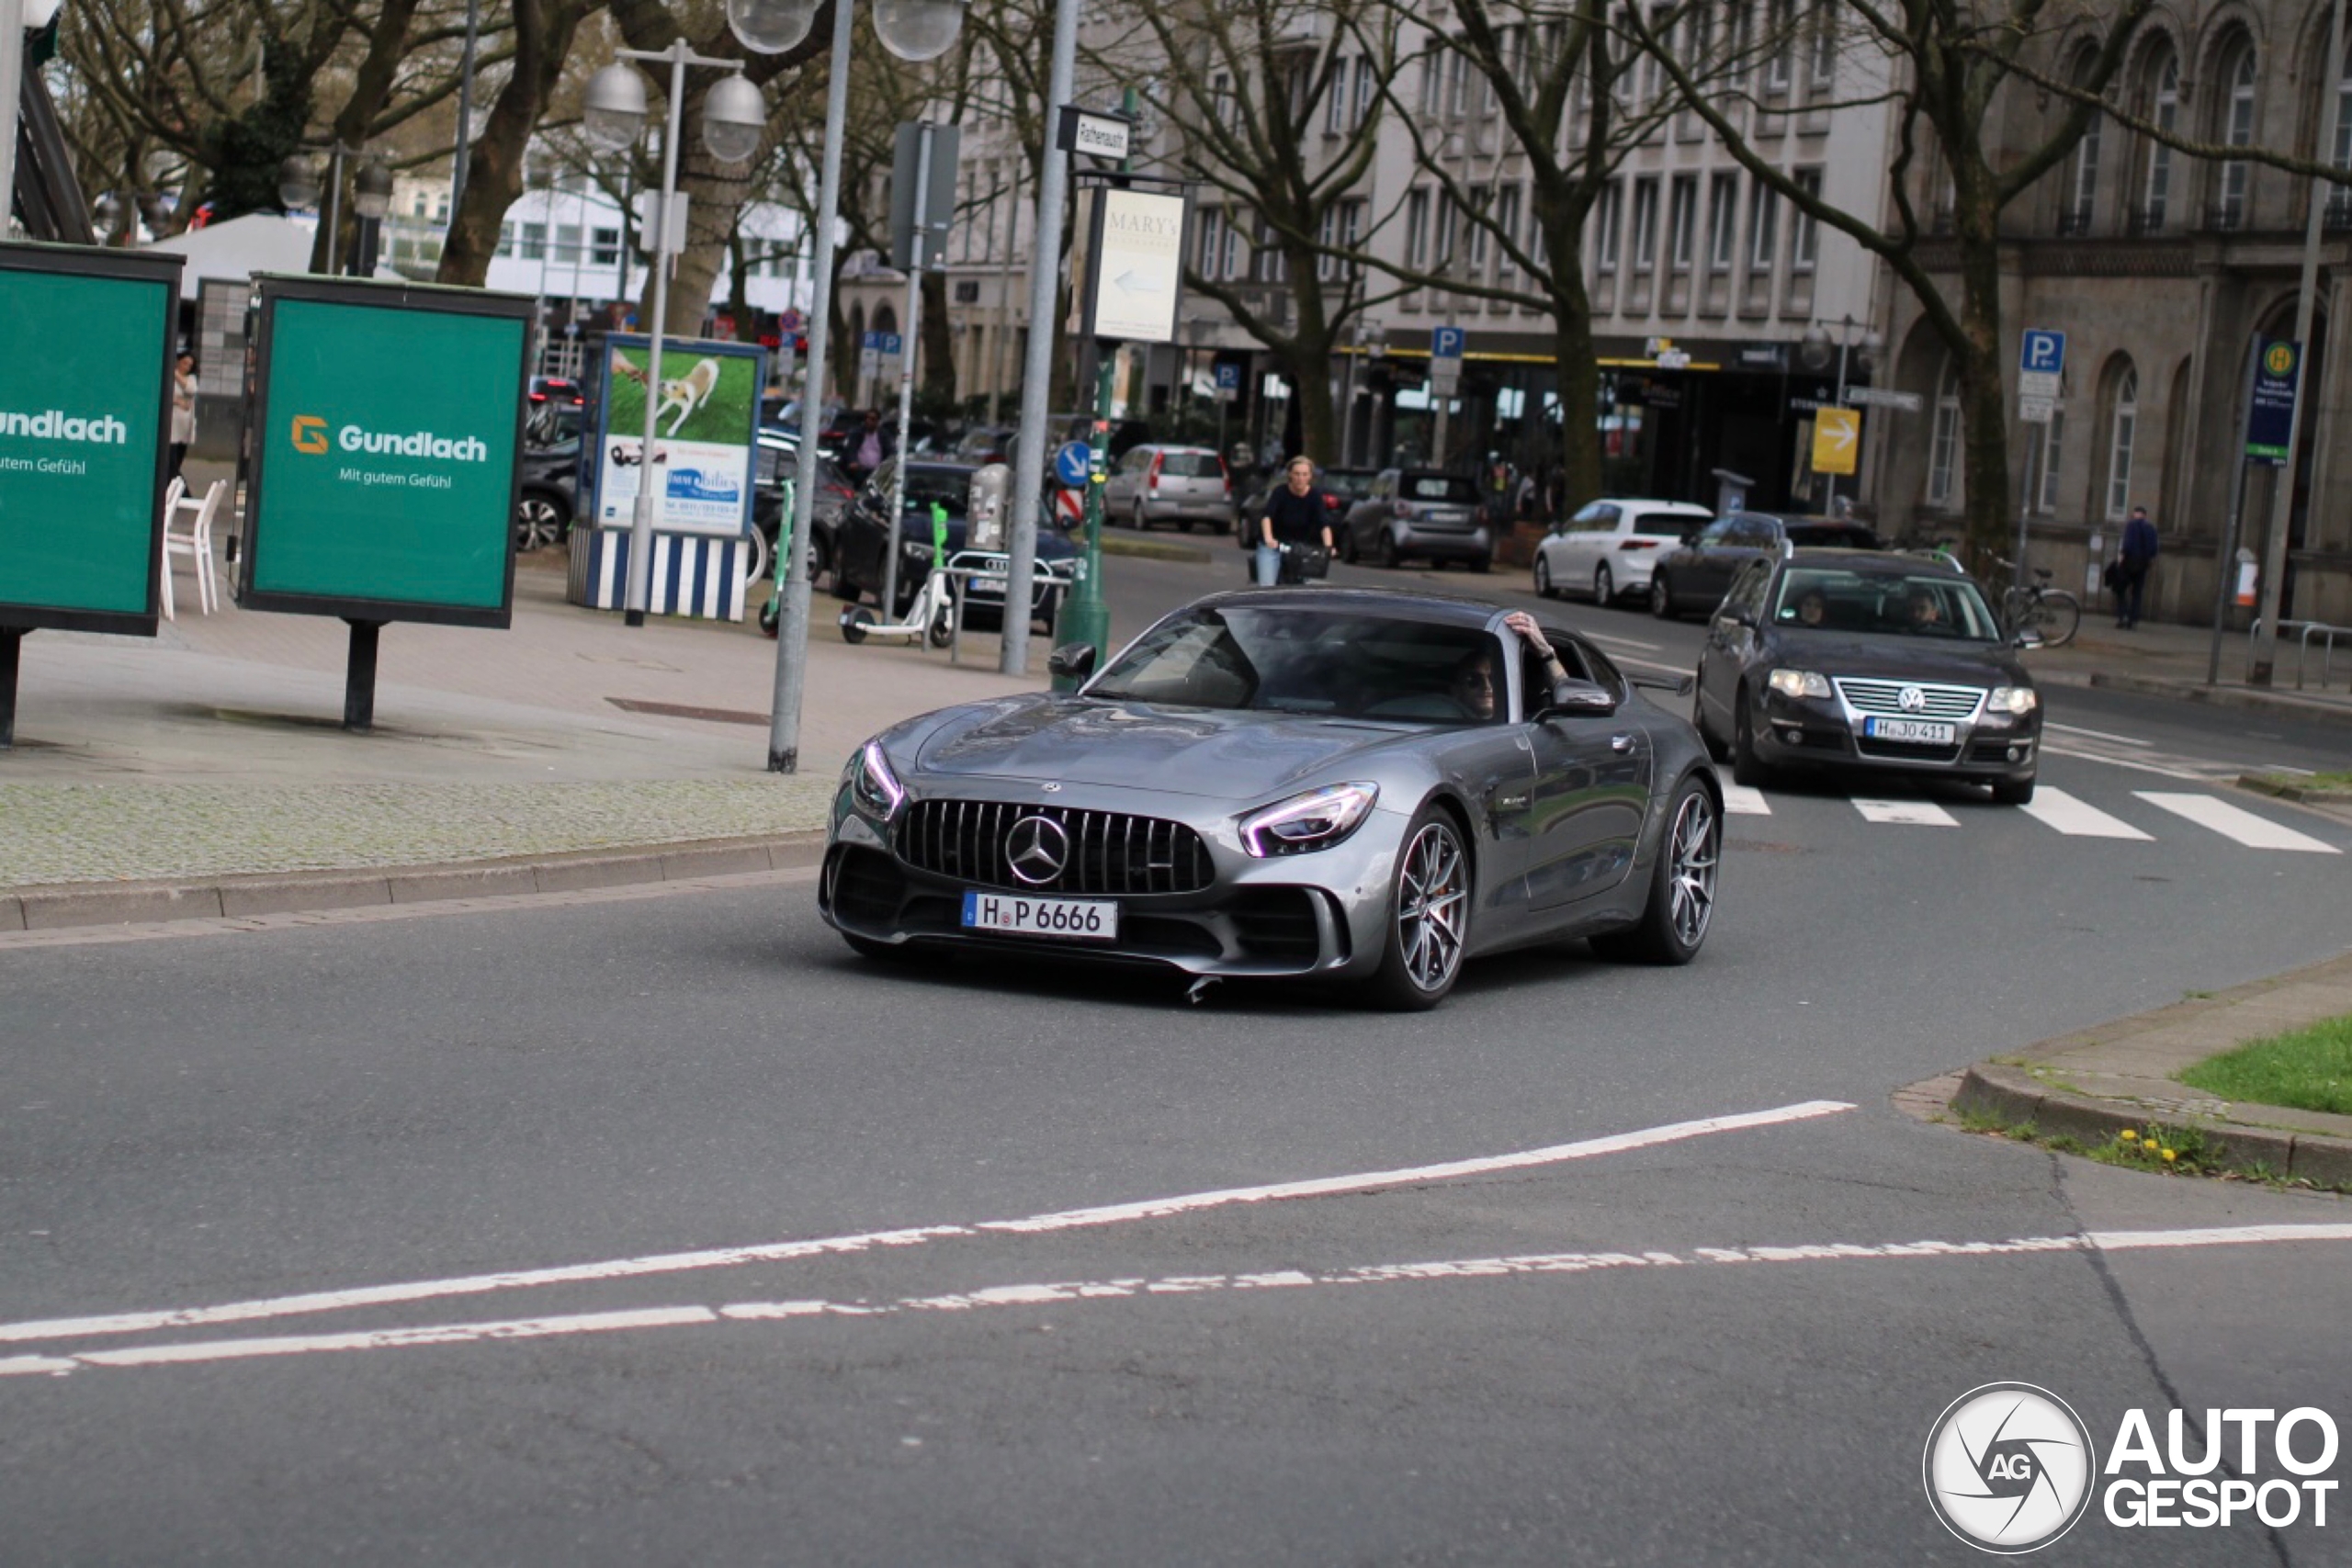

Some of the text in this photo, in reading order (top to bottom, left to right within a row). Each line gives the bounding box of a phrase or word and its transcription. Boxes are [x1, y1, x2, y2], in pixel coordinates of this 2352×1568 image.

[1439, 331, 1457, 354] P
[2031, 335, 2054, 367] P
[338, 424, 487, 462] Gundlach
[38, 457, 85, 475] Gefühl
[339, 468, 452, 489] Mit gutem Gefühl
[1879, 721, 1888, 735] H
[1919, 727, 1946, 739] 411
[983, 897, 1000, 924] H
[1015, 901, 1030, 927] P
[1035, 903, 1101, 931] 6666
